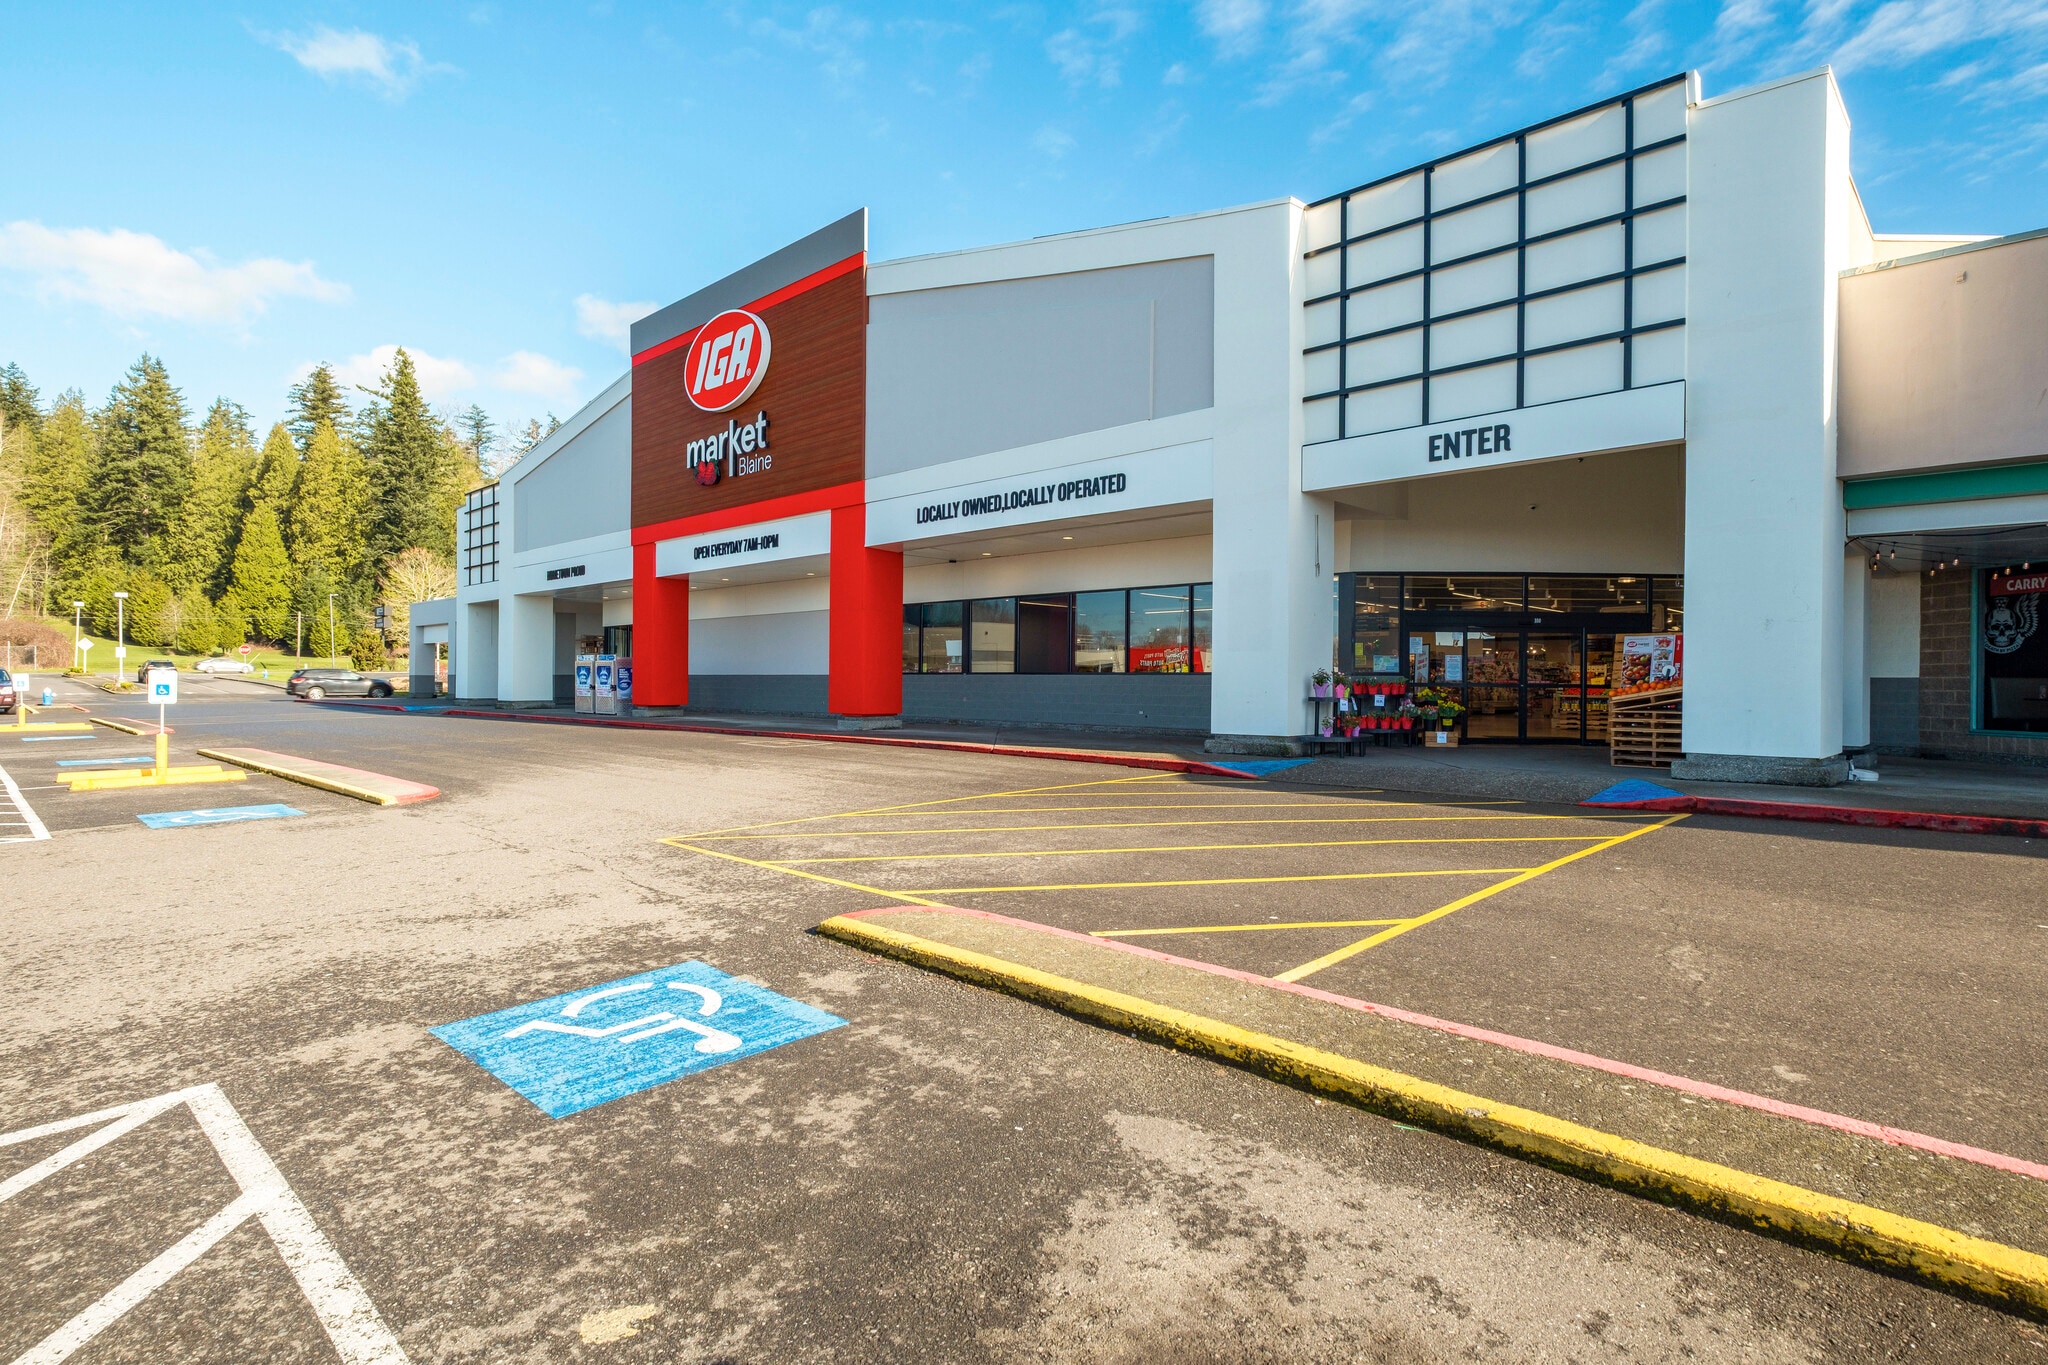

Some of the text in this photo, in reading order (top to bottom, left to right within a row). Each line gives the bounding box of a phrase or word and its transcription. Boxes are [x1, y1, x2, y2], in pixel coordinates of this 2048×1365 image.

[692, 323, 755, 395] IGA
[686, 411, 767, 477] market
[1428, 424, 1511, 462] ENTER
[739, 454, 772, 476] Blaine
[917, 502, 960, 524] LOCALLY
[1058, 473, 1127, 501] OPERATED
[694, 534, 779, 560] OPEN EVERYDAY 7AM-10PM
[2007, 577, 2047, 591] CARRY
[2006, 644, 2019, 652] PIZZA
